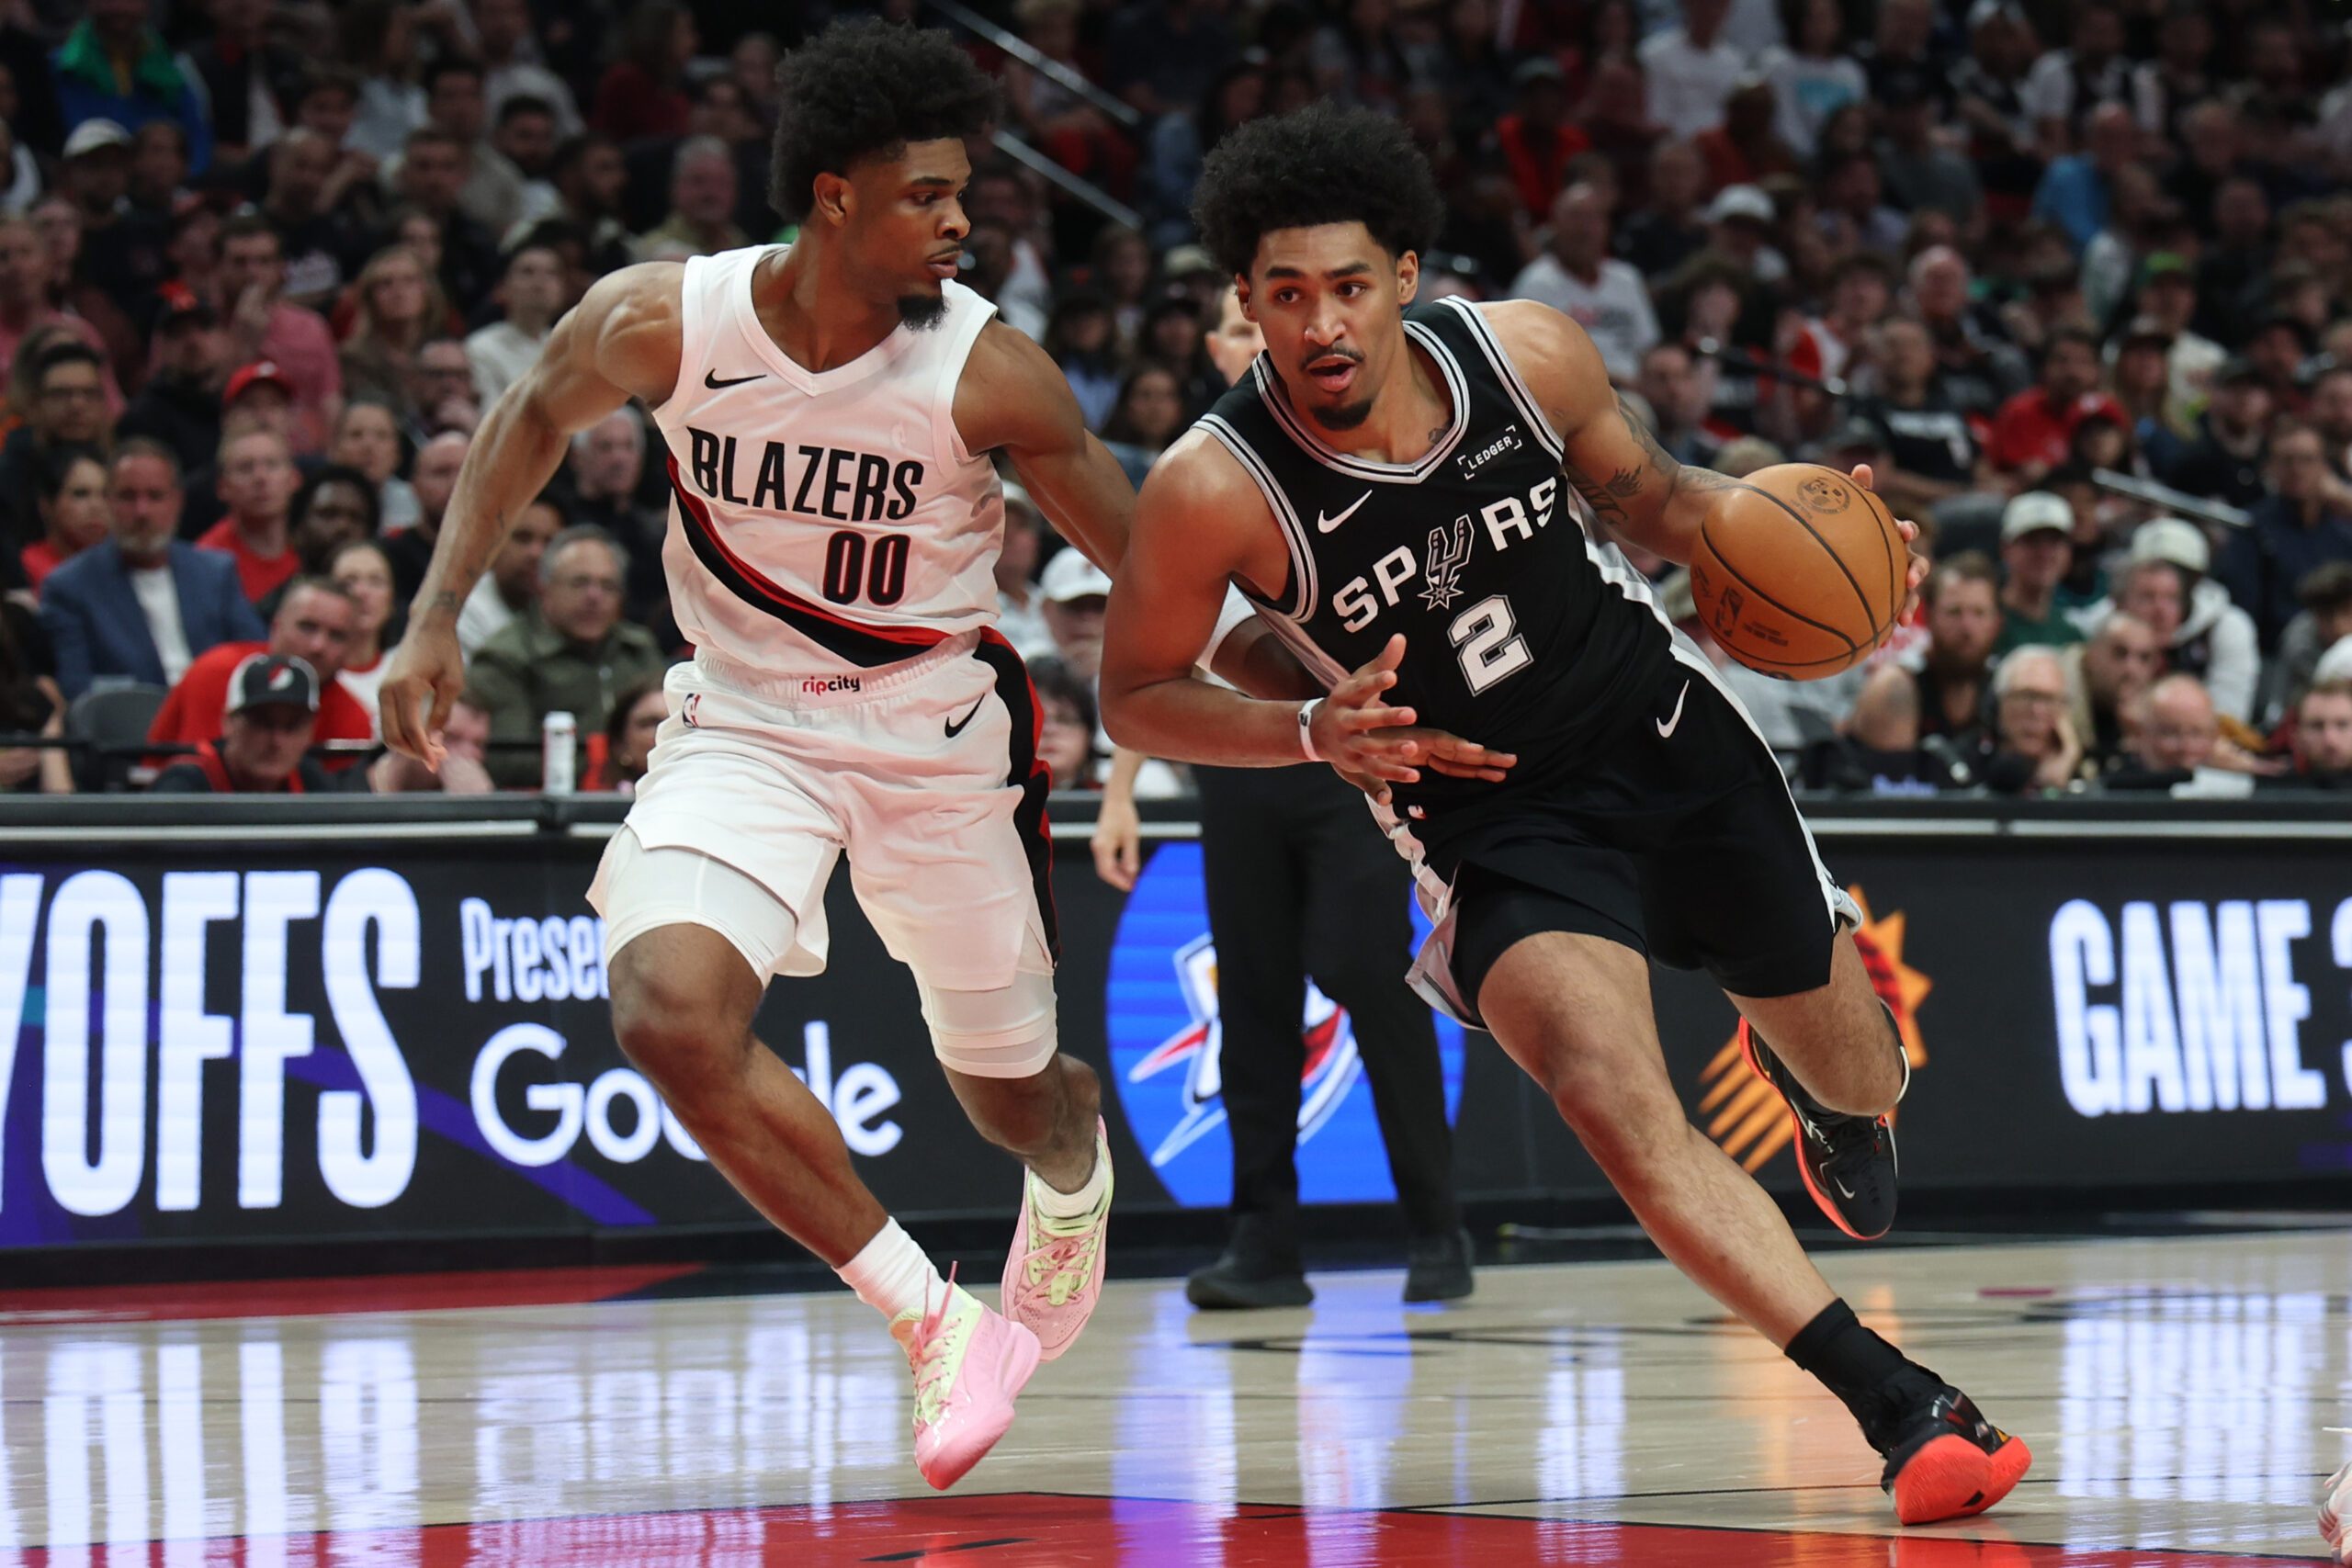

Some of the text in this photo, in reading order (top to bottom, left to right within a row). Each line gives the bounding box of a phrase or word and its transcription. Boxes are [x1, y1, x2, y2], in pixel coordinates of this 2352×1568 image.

[685, 425, 925, 523] BLAZERS
[1466, 434, 1514, 471] LEDGER
[821, 529, 911, 606] 00
[1332, 476, 1557, 634] SPURS
[1446, 593, 1535, 697] 2
[2049, 897, 2328, 1119] GAME
[469, 1021, 904, 1168] Gole
